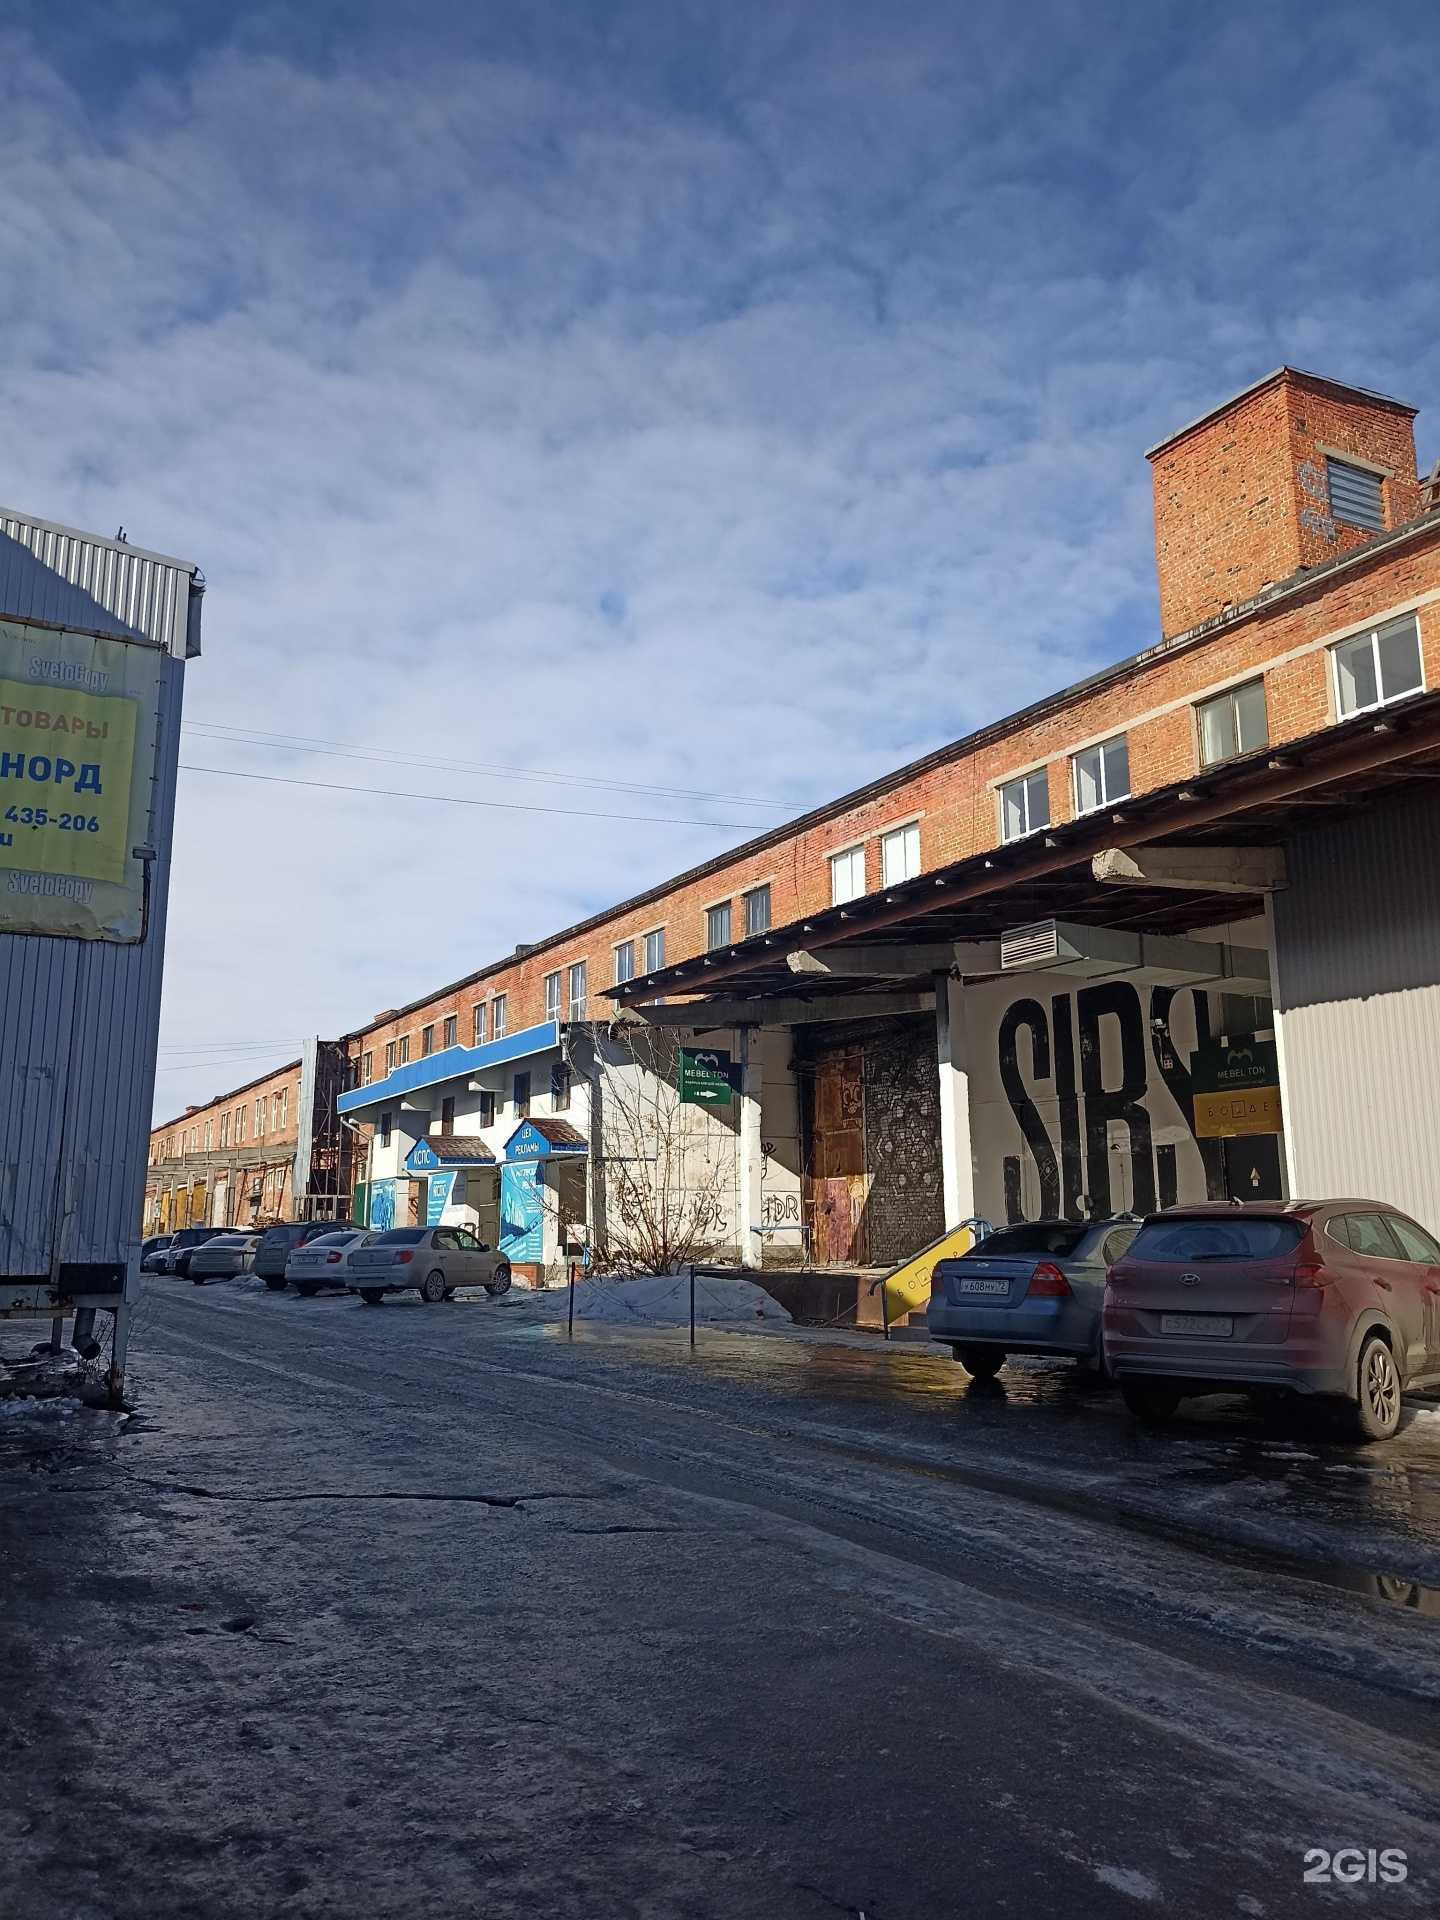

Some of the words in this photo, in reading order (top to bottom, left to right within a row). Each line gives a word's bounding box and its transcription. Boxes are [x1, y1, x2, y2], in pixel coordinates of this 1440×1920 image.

[1, 706, 109, 739] ТОВАРЫ
[0, 752, 103, 795] НОРД
[4, 805, 100, 833] 435-206
[684, 1068, 711, 1079] MEBEL
